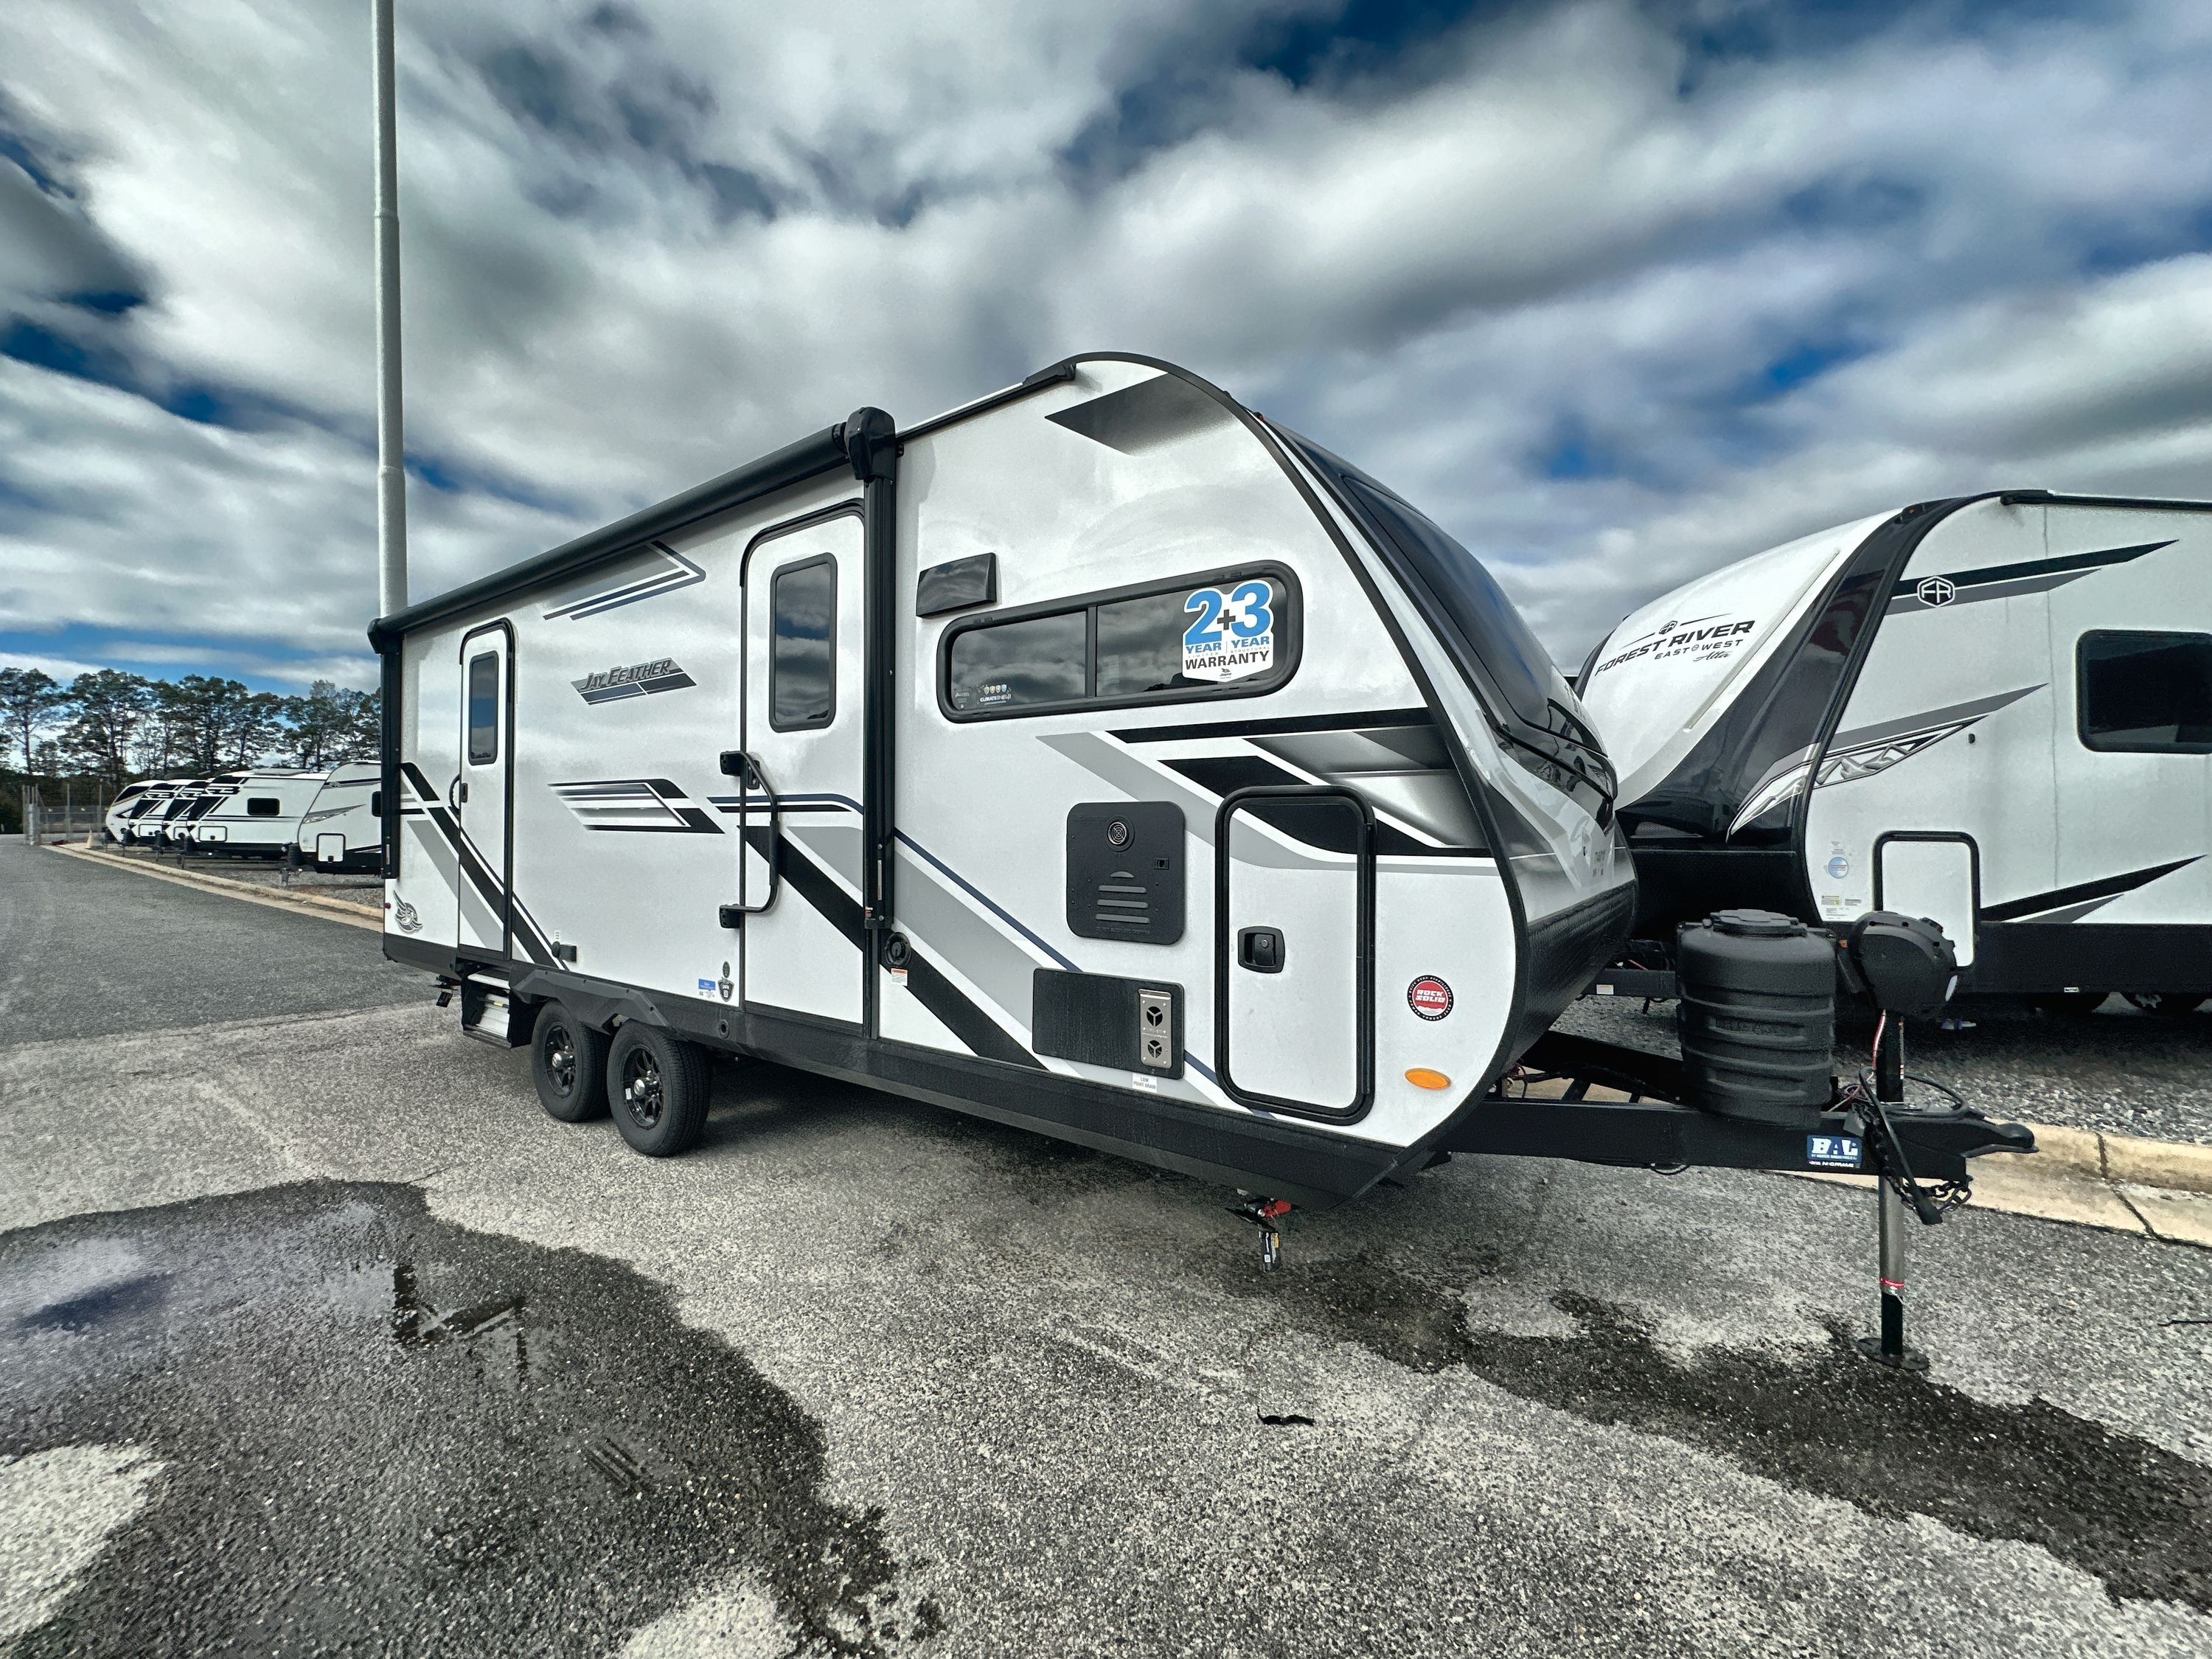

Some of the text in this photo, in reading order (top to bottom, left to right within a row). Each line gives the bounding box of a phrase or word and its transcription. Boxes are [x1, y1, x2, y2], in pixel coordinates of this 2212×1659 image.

[1186, 641, 1222, 654] YEAR
[1231, 636, 1270, 649] YEAR
[1594, 620, 1756, 677] FOREST RIVER
[1654, 639, 1744, 660] EAST WEST
[1185, 650, 1270, 669] WARRANTY
[1416, 989, 1444, 997] ROCK
[1812, 1138, 1858, 1156] BAL
